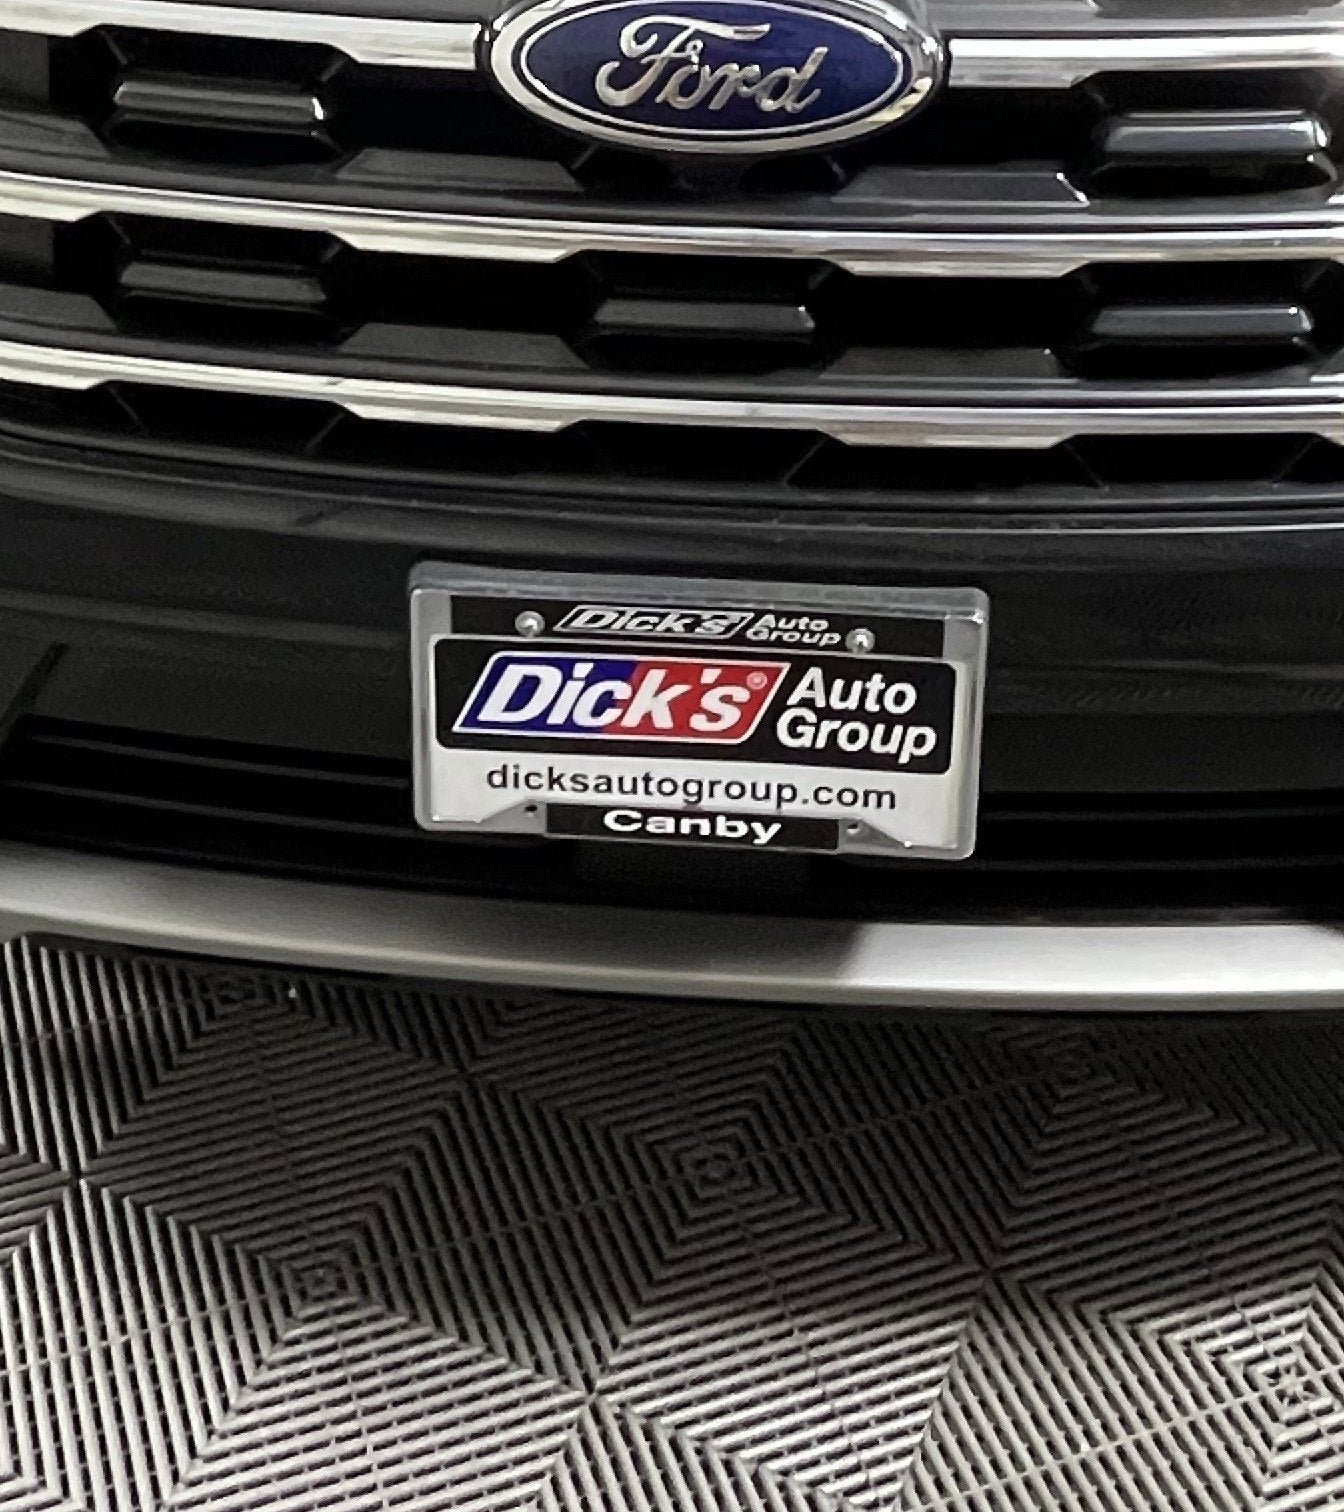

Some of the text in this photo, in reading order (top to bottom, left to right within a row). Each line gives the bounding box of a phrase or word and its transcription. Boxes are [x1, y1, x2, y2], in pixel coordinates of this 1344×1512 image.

[595, 15, 828, 112] Ford
[746, 628, 841, 647] Group
[752, 613, 829, 632] Auto
[477, 662, 751, 732] Dick's
[787, 668, 917, 713] Auto
[776, 708, 937, 764] Group
[486, 764, 897, 811] dicksautogroup.com
[602, 809, 782, 844] Canby
